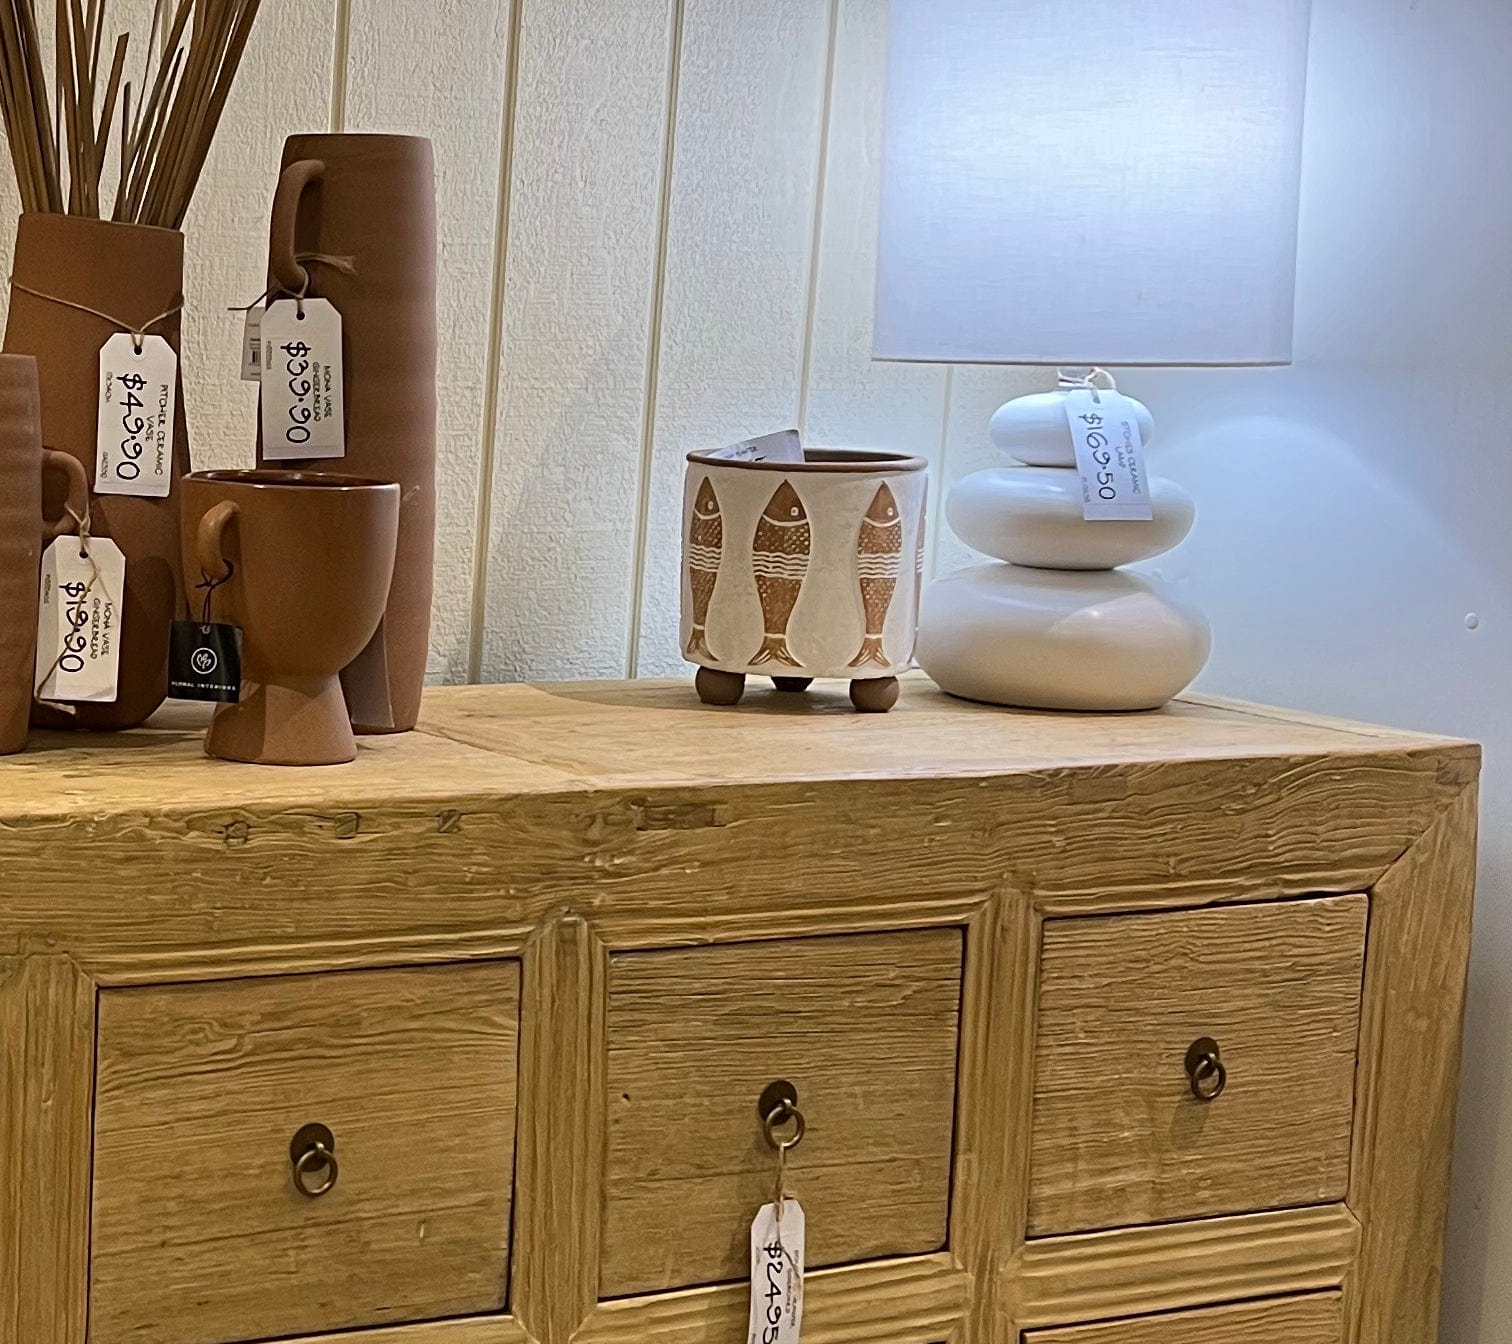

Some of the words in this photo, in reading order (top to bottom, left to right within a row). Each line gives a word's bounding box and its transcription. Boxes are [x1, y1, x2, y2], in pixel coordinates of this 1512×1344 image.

[158, 384, 168, 427] PITCHER
[281, 342, 311, 443] $39.90
[324, 396, 332, 417] VASE
[117, 374, 147, 480] $49.90
[155, 431, 165, 475] CERAMIC
[1078, 414, 1116, 499] $169.50
[1127, 457, 1141, 495] CERAMIC
[59, 582, 88, 672] $19.90
[101, 633, 109, 656] VASE
